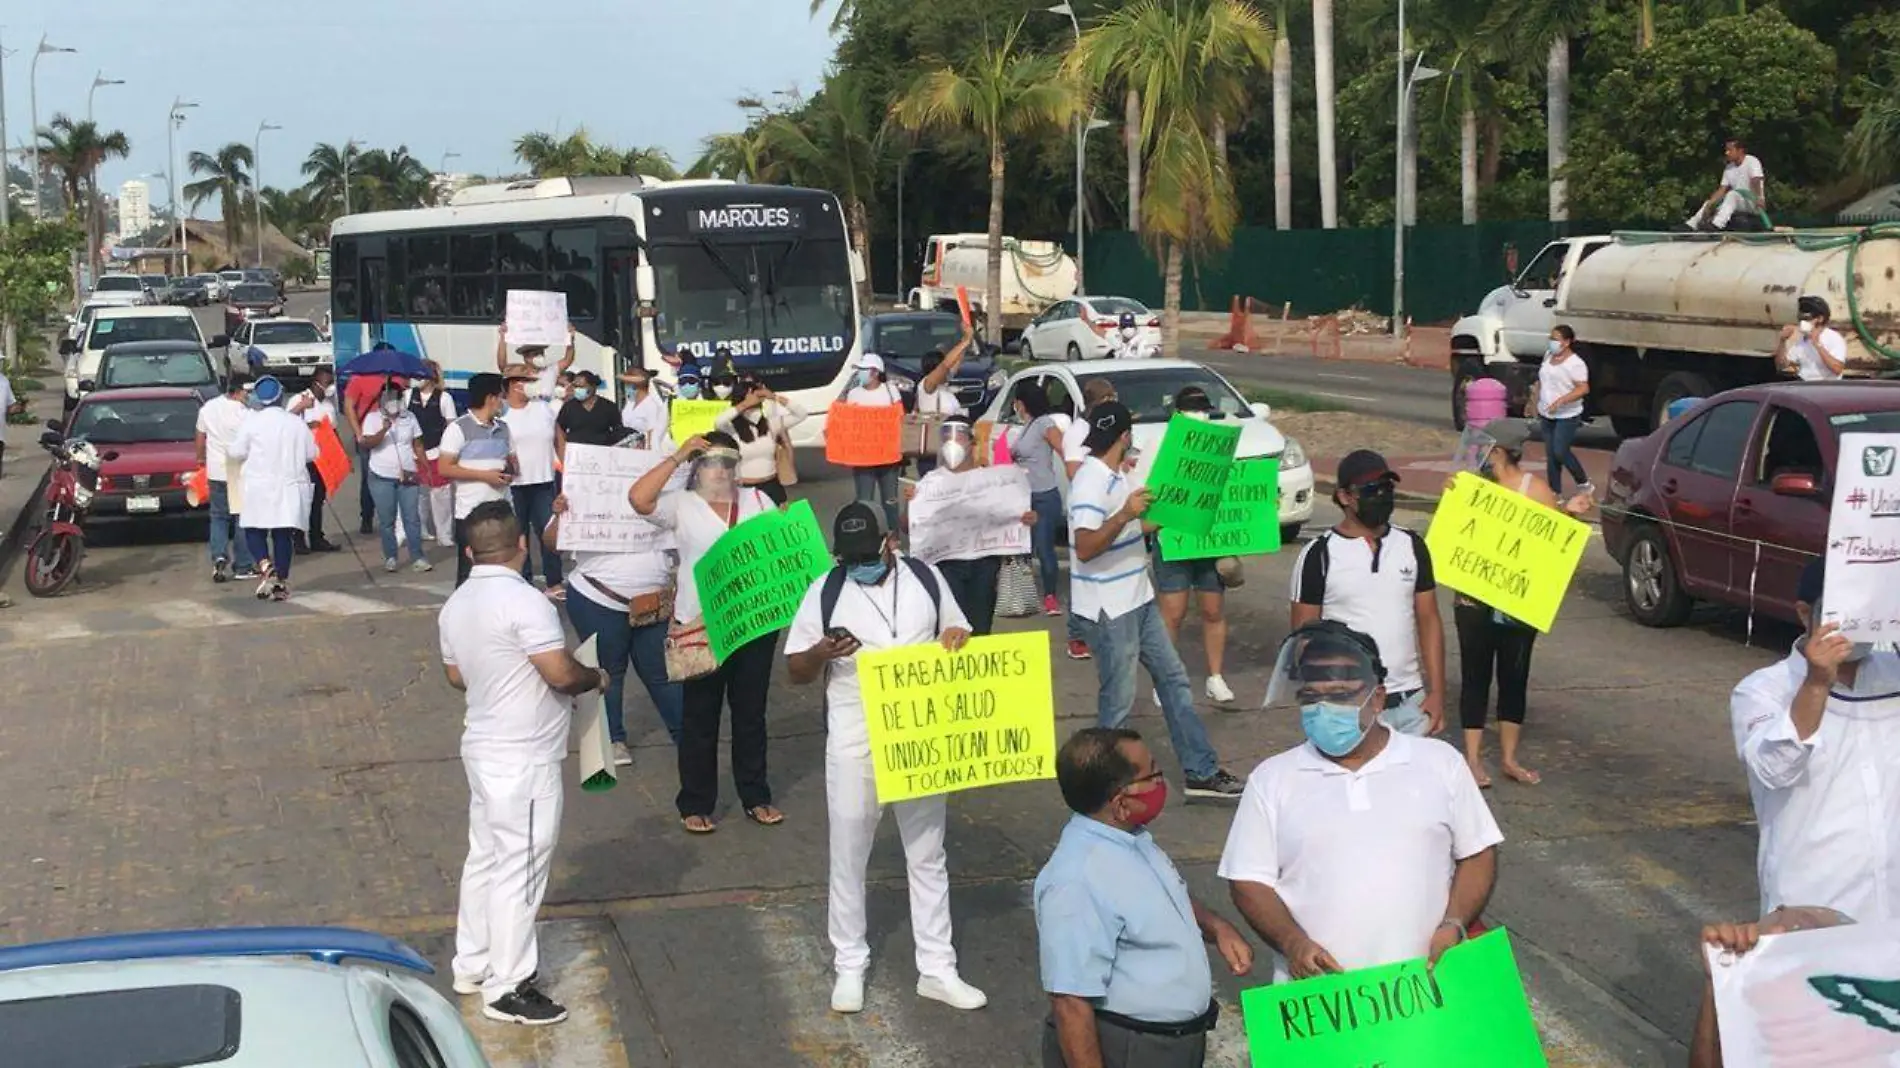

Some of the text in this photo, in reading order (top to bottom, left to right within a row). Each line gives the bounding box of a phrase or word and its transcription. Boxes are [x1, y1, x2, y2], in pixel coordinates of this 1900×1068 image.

[700, 208, 789, 229] MARQUES
[771, 335, 844, 354] ZOCALO
[780, 522, 810, 549] LOS
[1459, 518, 1522, 561] A LA
[1449, 547, 1531, 600] REPRESIÓN
[873, 650, 1026, 691] TRABAJADORES
[881, 688, 996, 731] DE LA SALUD
[884, 726, 1032, 773] UNIDOS TOCAN UNO
[905, 767, 963, 792] TOCAN
[966, 764, 978, 782] A
[1279, 963, 1445, 1041] REVISIÓN
